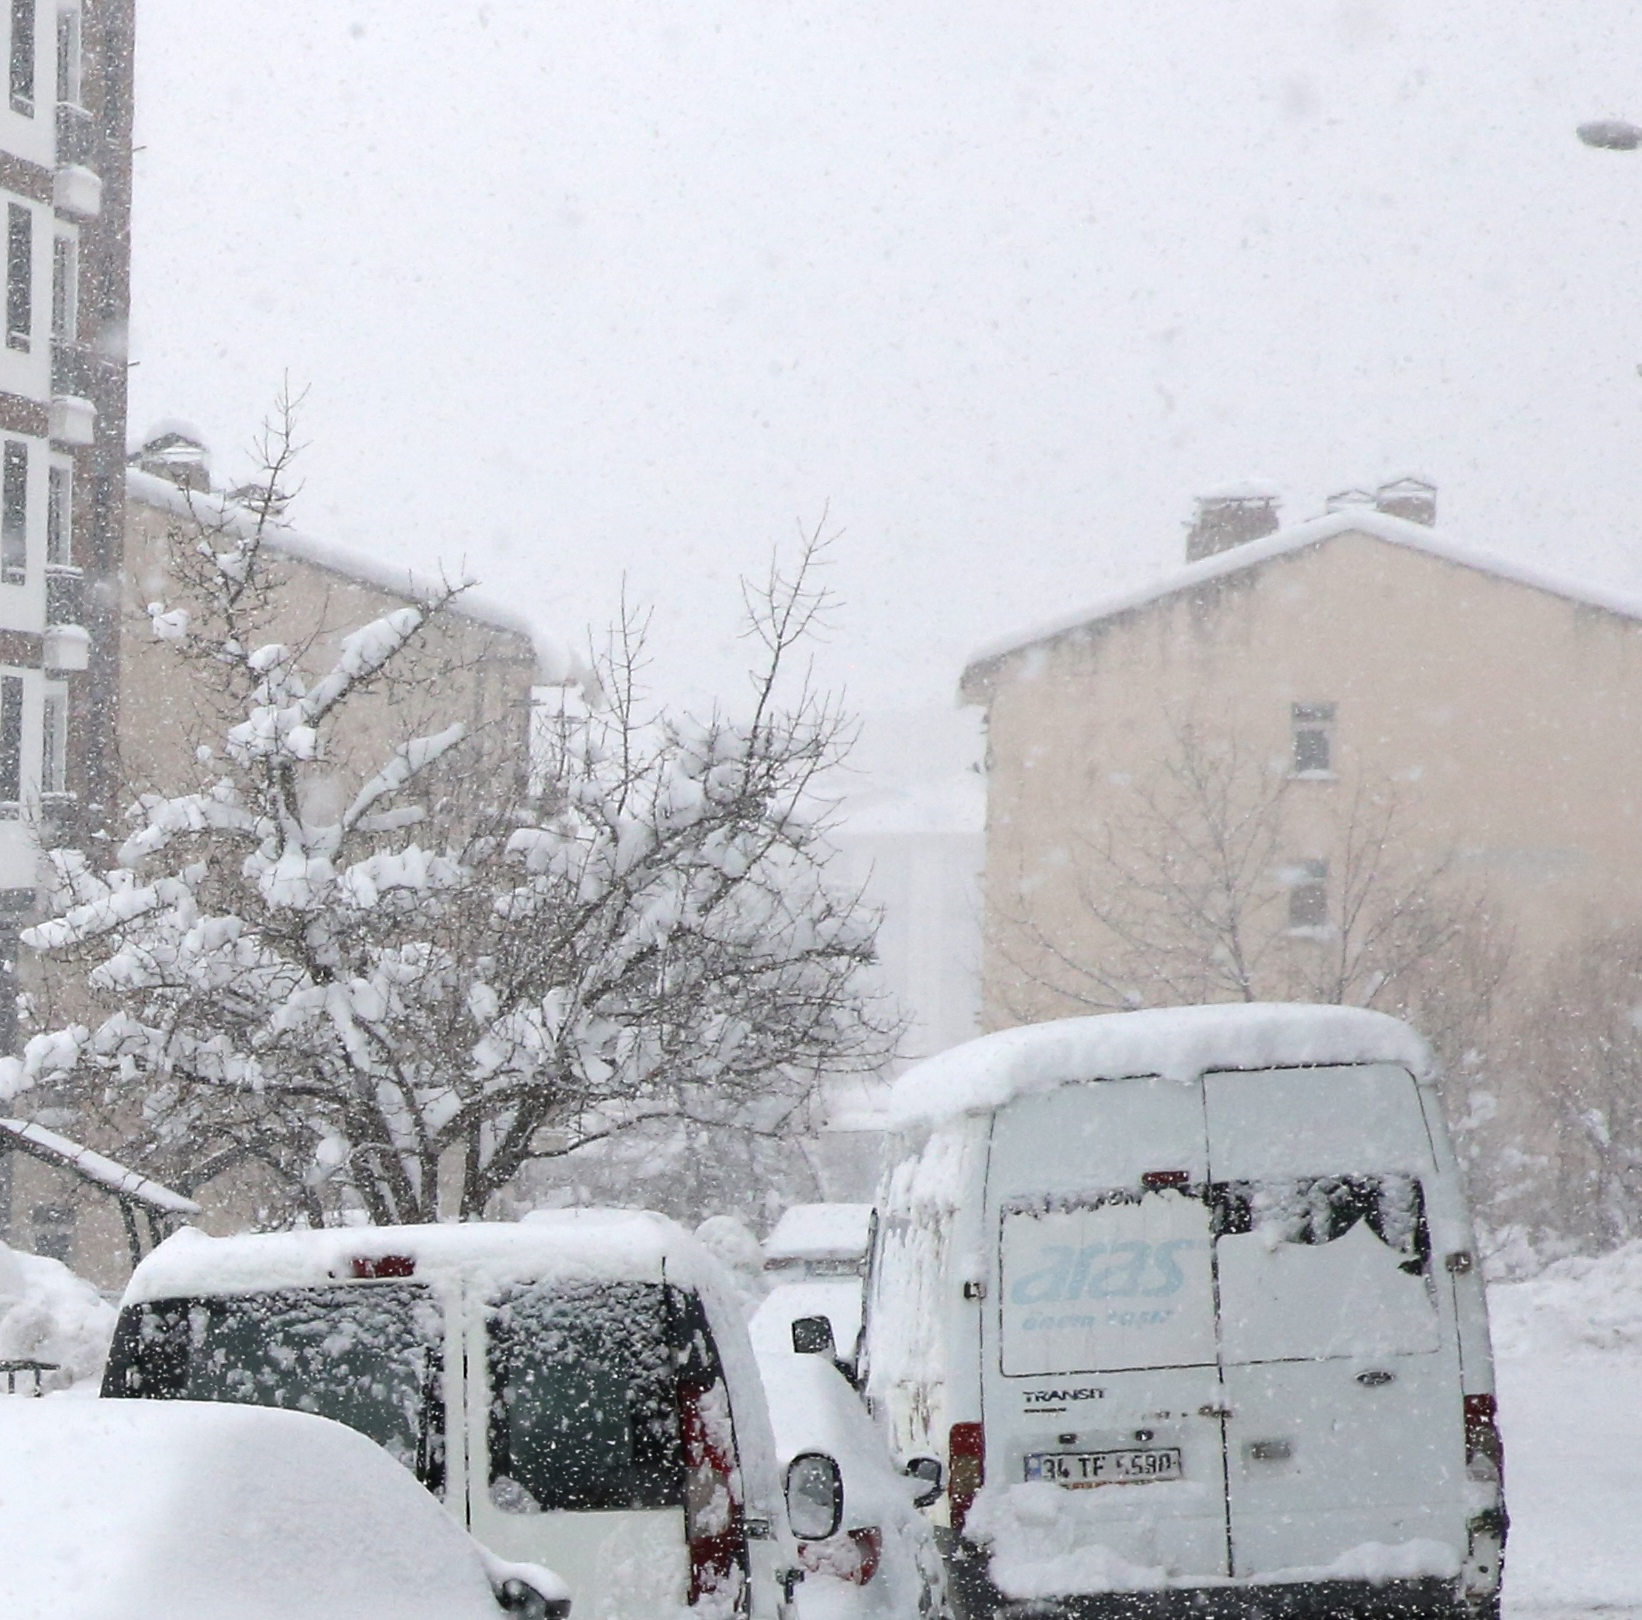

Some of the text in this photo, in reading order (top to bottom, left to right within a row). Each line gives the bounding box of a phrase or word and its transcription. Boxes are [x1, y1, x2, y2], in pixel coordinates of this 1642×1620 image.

[1011, 1239, 1196, 1305] aras
[1023, 1388, 1107, 1403] TRANSIT
[1043, 1458, 1070, 1480] 34
